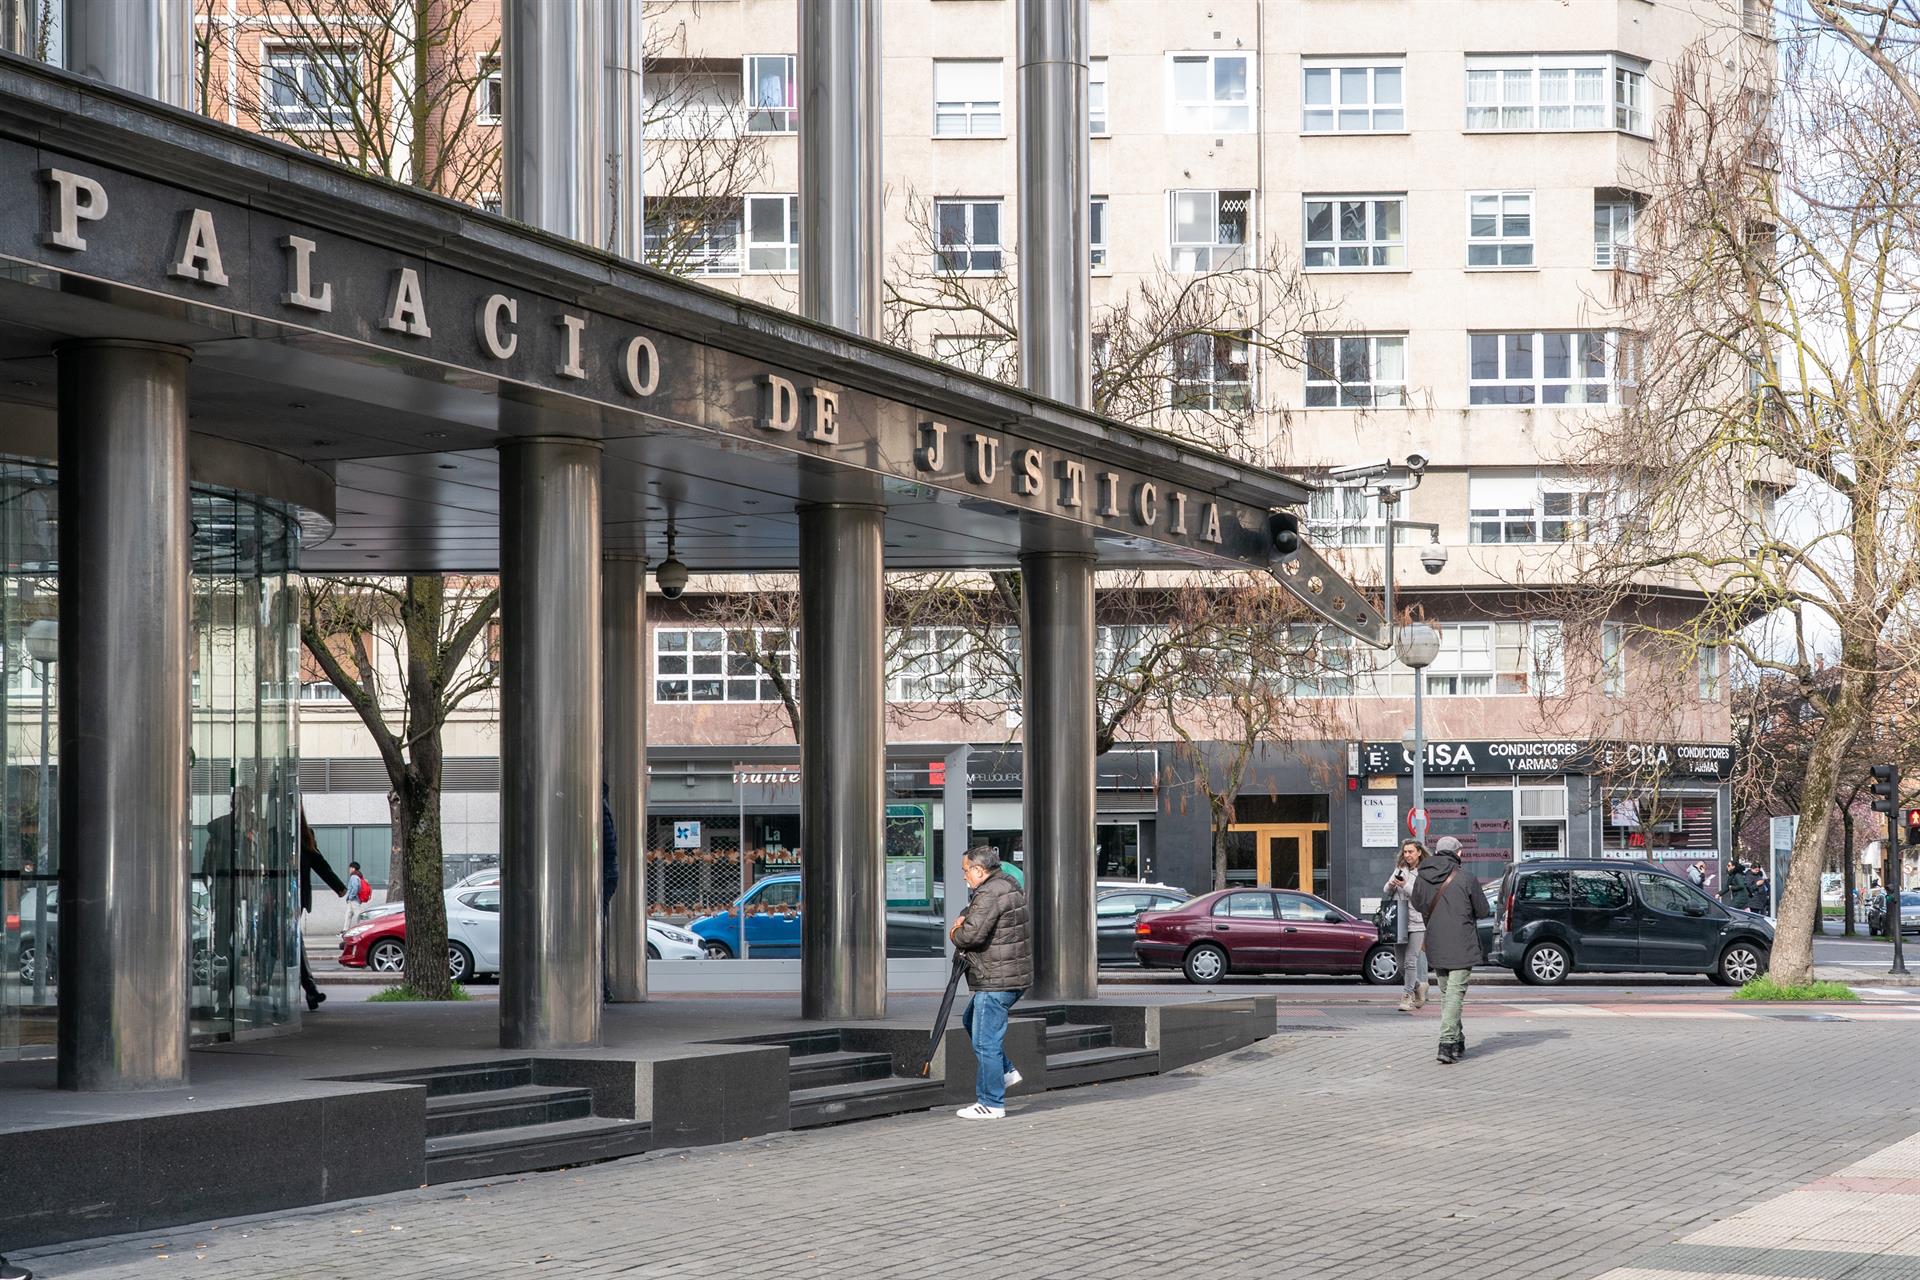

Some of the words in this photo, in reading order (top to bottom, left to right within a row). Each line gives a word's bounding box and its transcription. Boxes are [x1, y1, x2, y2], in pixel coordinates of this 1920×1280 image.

[41, 167, 661, 398] PALACIO
[756, 374, 839, 445] DE
[913, 421, 1223, 545] JUSTICIA
[1403, 743, 1475, 765] CISA
[1488, 743, 1577, 756] CONDUCTORES
[1677, 746, 1729, 759] CONDUCTORES
[1369, 752, 1381, 765] E
[1507, 758, 1516, 770] Y
[1518, 758, 1558, 770] ARMAS
[1695, 761, 1719, 773] ARMAS
[765, 825, 780, 841] La
